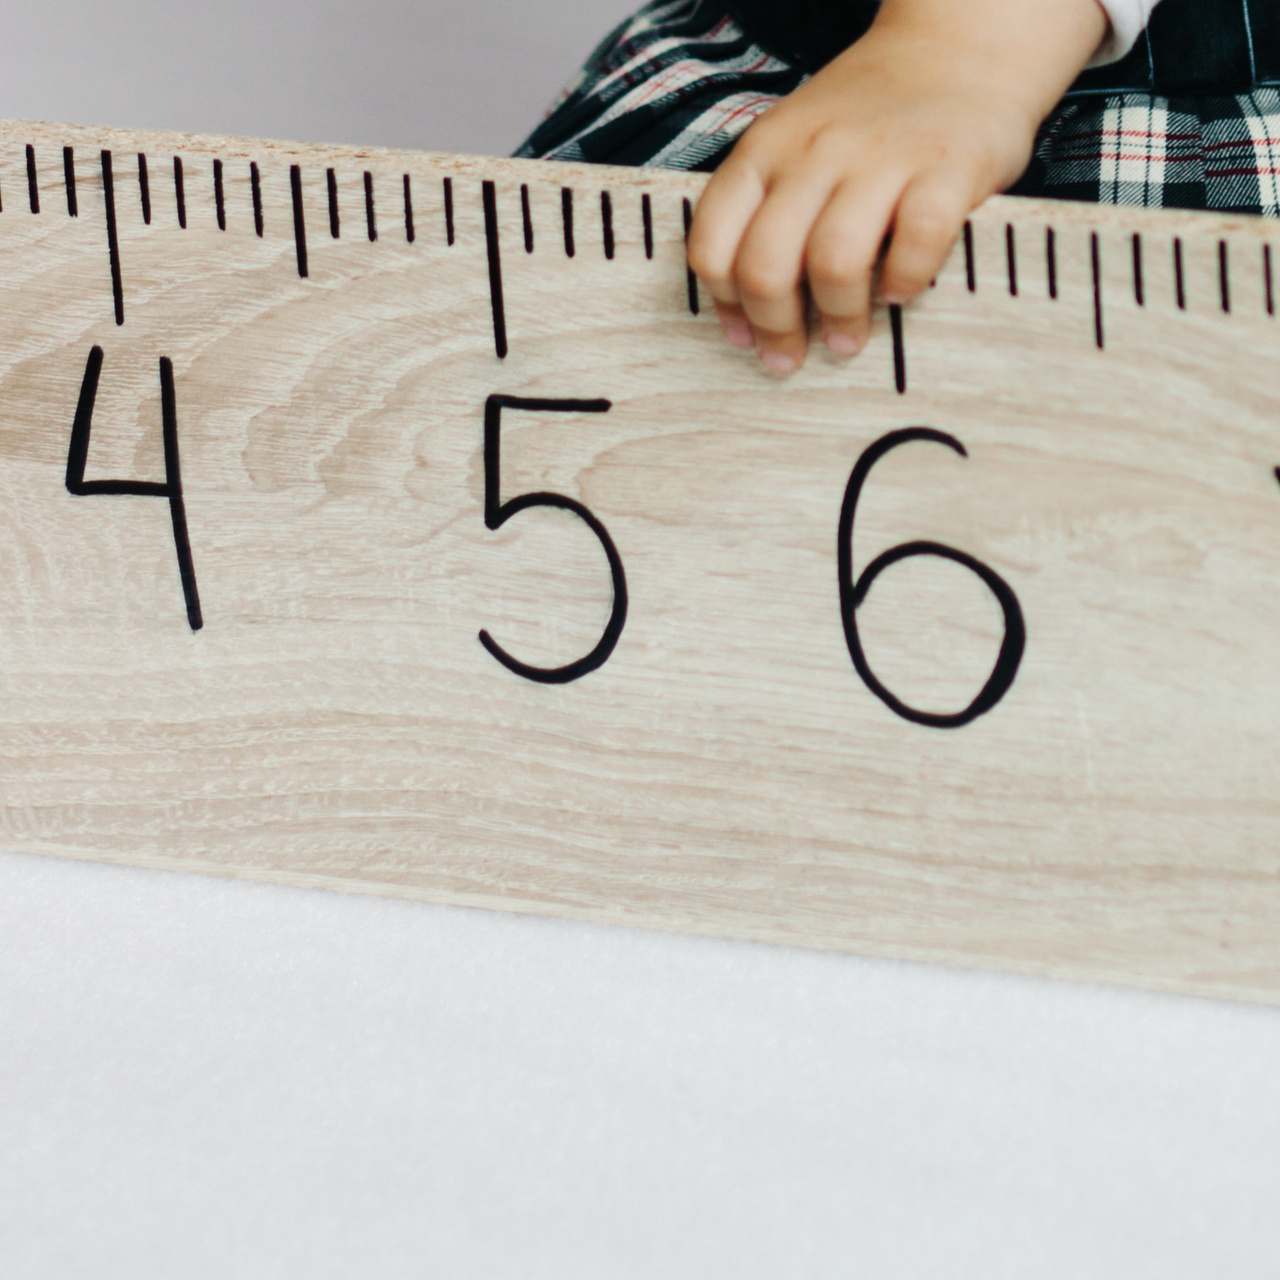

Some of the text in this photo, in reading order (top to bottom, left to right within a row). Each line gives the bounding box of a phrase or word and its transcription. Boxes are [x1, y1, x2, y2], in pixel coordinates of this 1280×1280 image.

[65, 344, 204, 631] 4
[478, 393, 629, 685] 5
[836, 426, 1027, 730] 6
